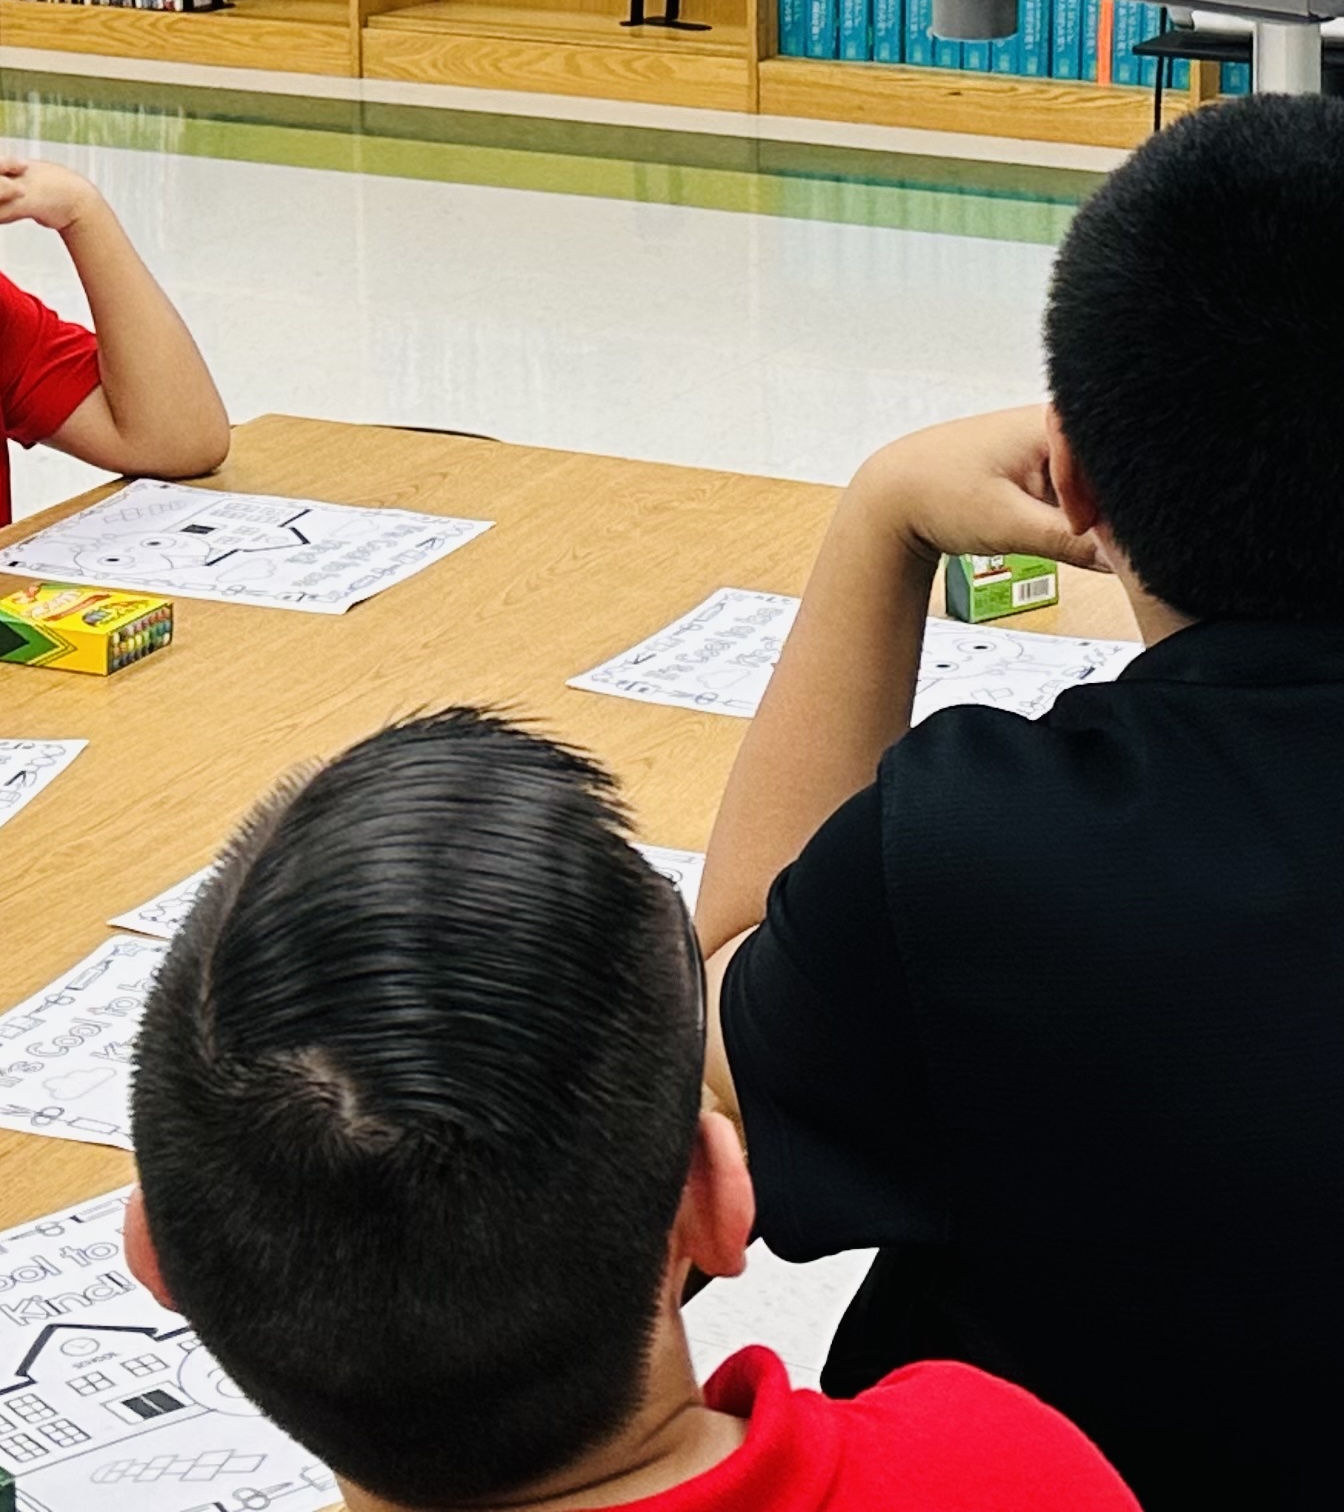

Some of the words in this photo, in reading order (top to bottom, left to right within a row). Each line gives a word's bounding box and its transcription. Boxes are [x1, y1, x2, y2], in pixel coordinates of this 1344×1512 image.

[26, 1017, 113, 1058] Cool
[59, 1241, 119, 1268] to
[72, 1351, 121, 1369] SCHOOL
